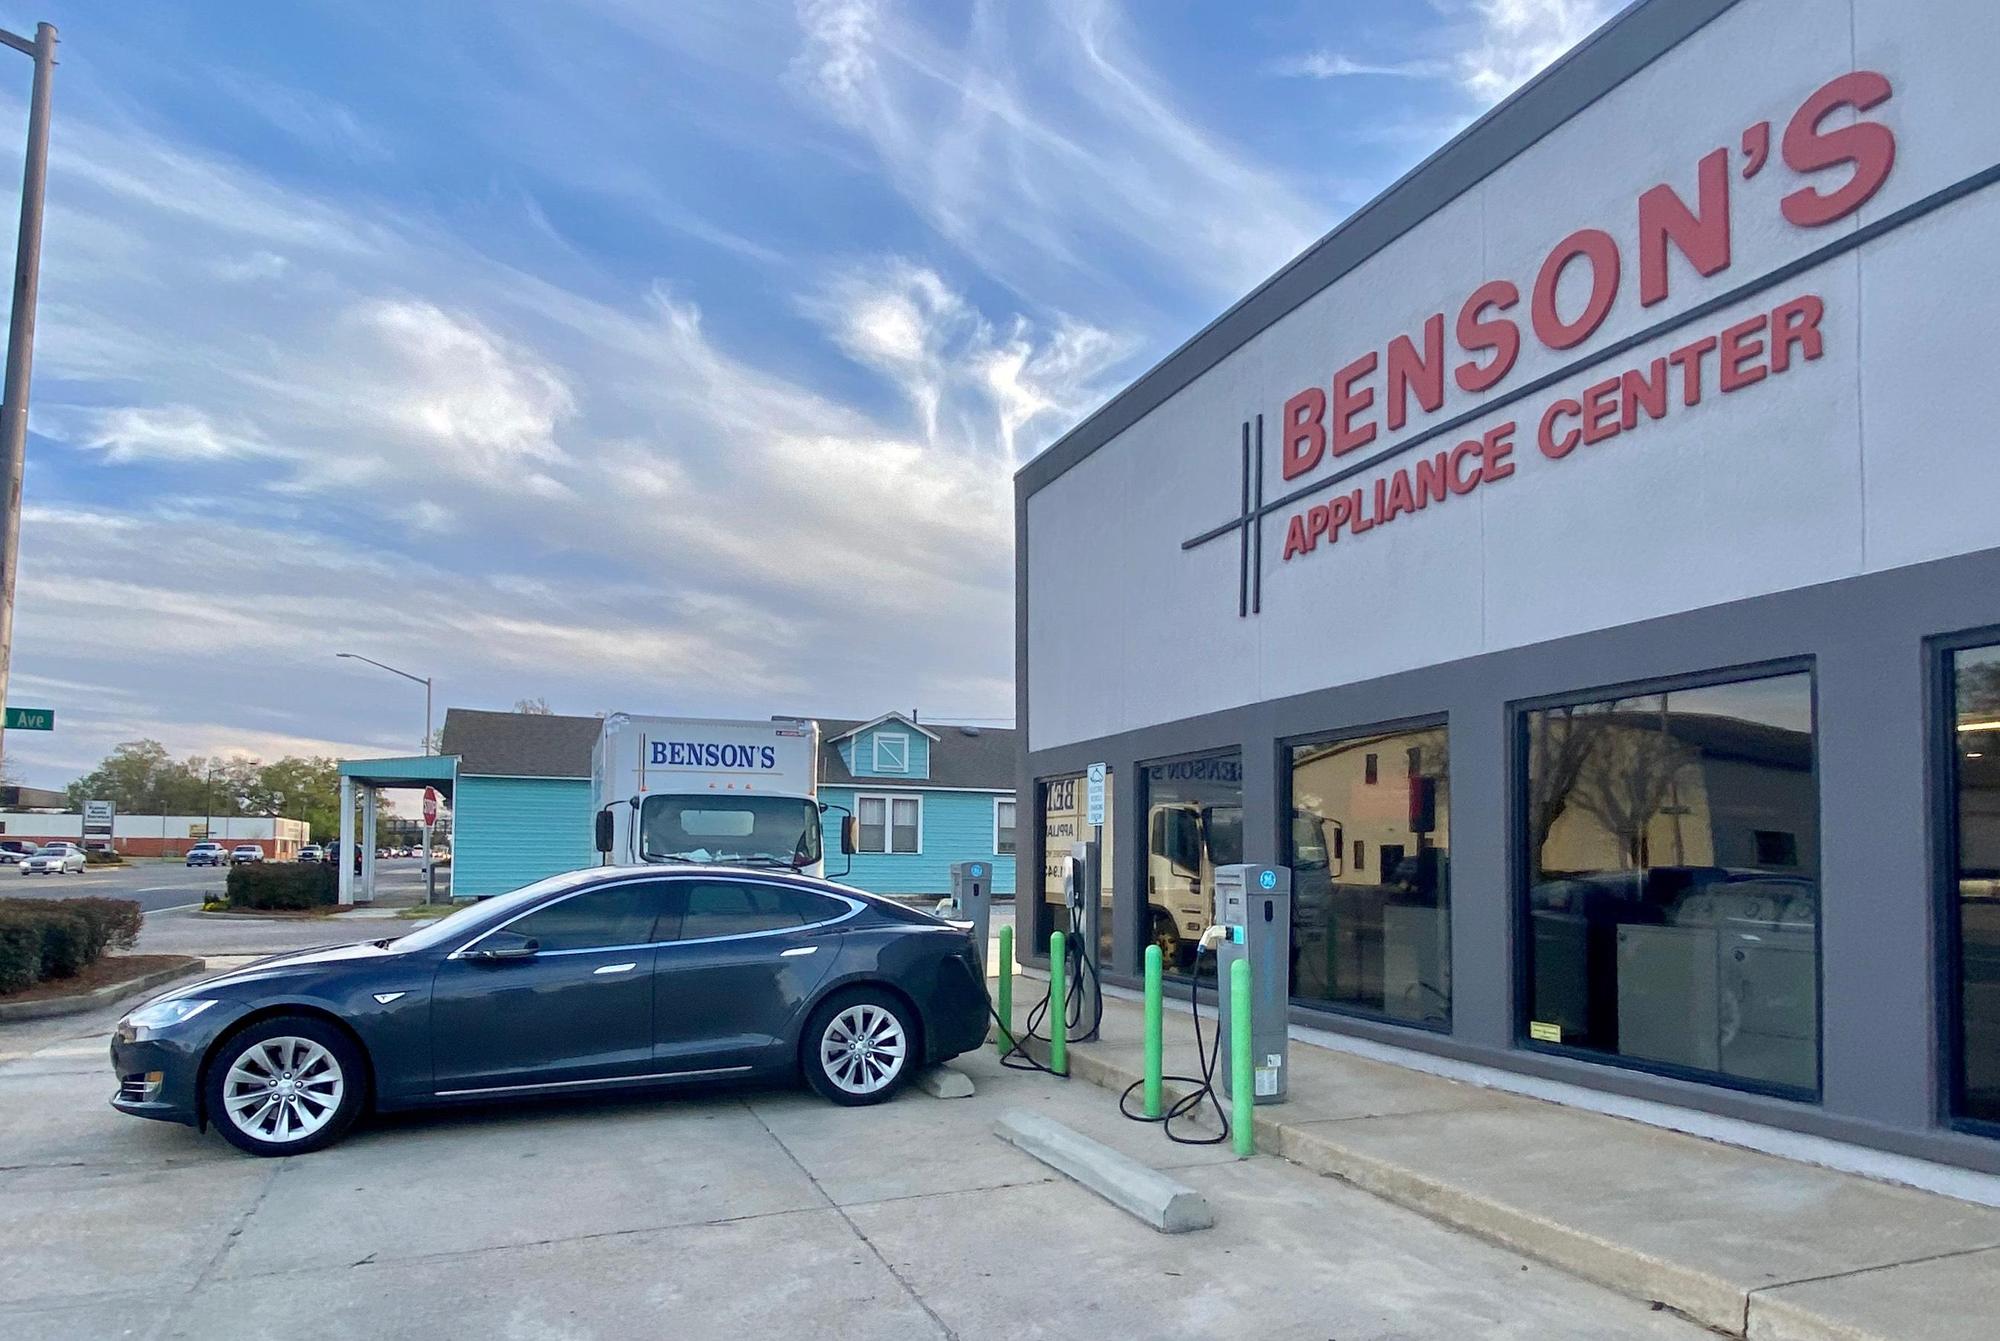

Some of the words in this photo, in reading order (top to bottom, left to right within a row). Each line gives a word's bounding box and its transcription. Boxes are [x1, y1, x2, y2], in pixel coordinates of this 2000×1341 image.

[1283, 71, 1895, 480] BENSON'S
[1284, 421, 1515, 559] APPLIANCE
[1538, 295, 1824, 458] CENTER
[17, 711, 44, 728] Ave
[651, 742, 775, 769] BENSON'S
